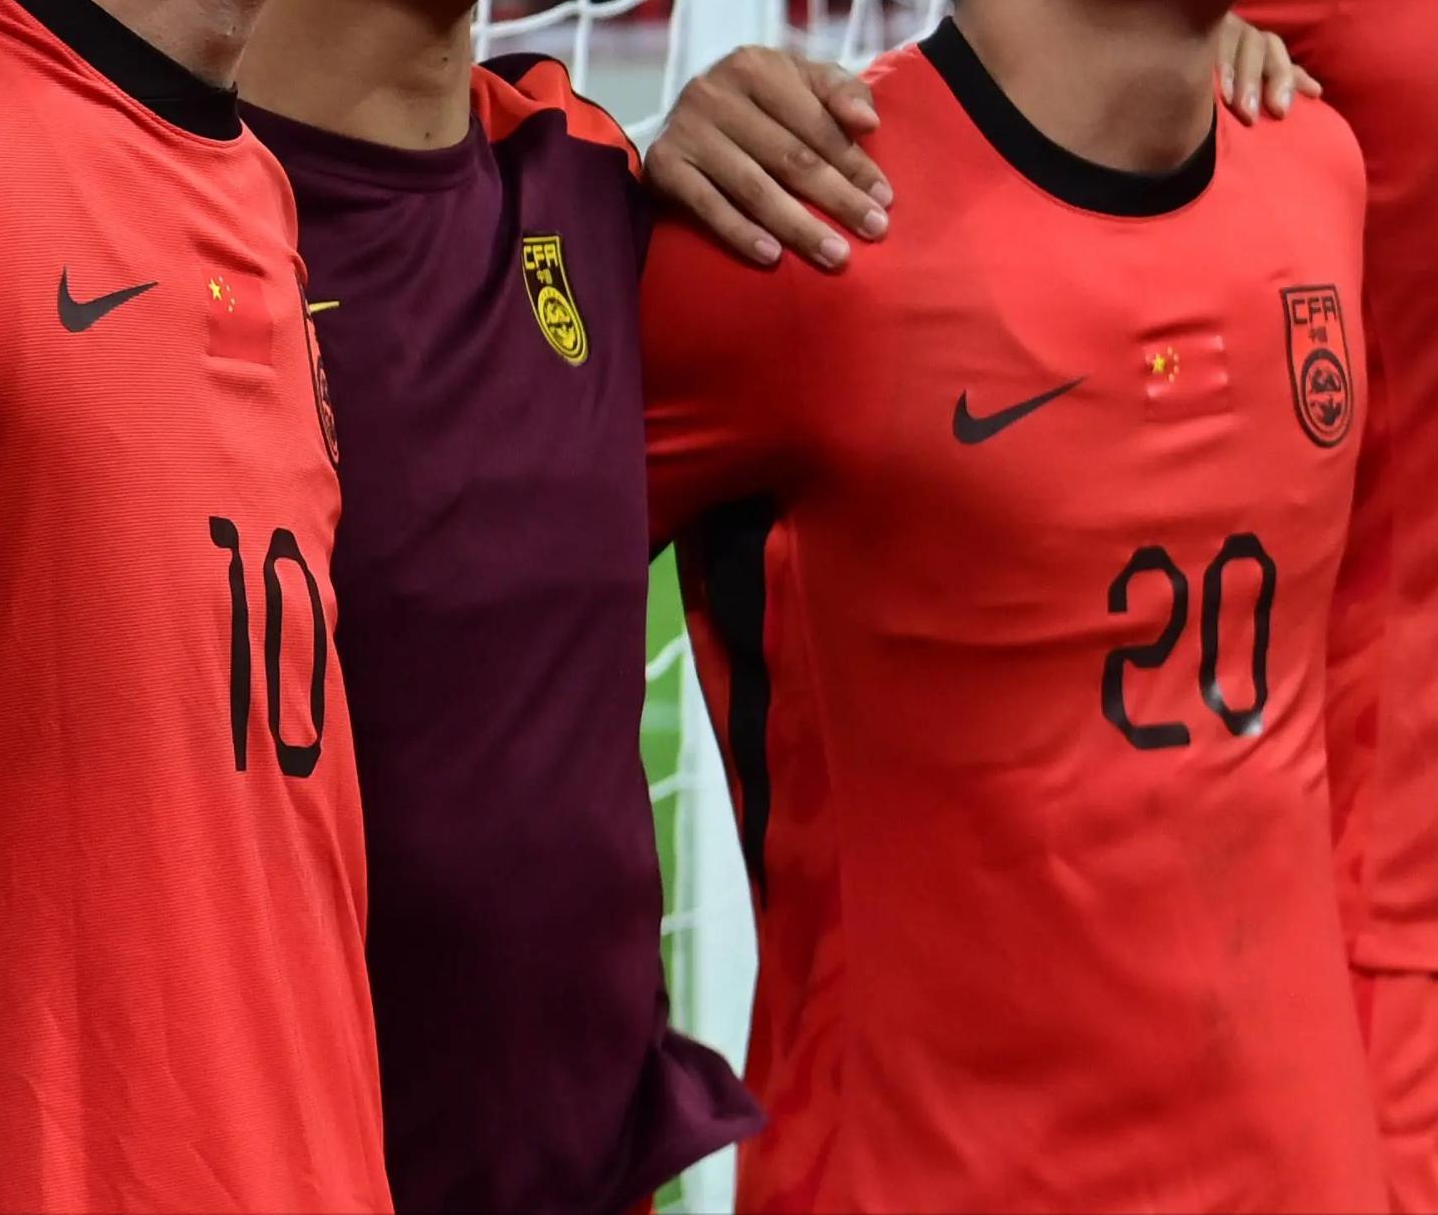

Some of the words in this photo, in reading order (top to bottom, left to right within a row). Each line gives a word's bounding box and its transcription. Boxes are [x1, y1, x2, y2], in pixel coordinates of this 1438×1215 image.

[523, 242, 559, 270] CFA
[1291, 296, 1337, 325] CFA
[209, 516, 328, 777] 10
[1100, 531, 1278, 750] 20
